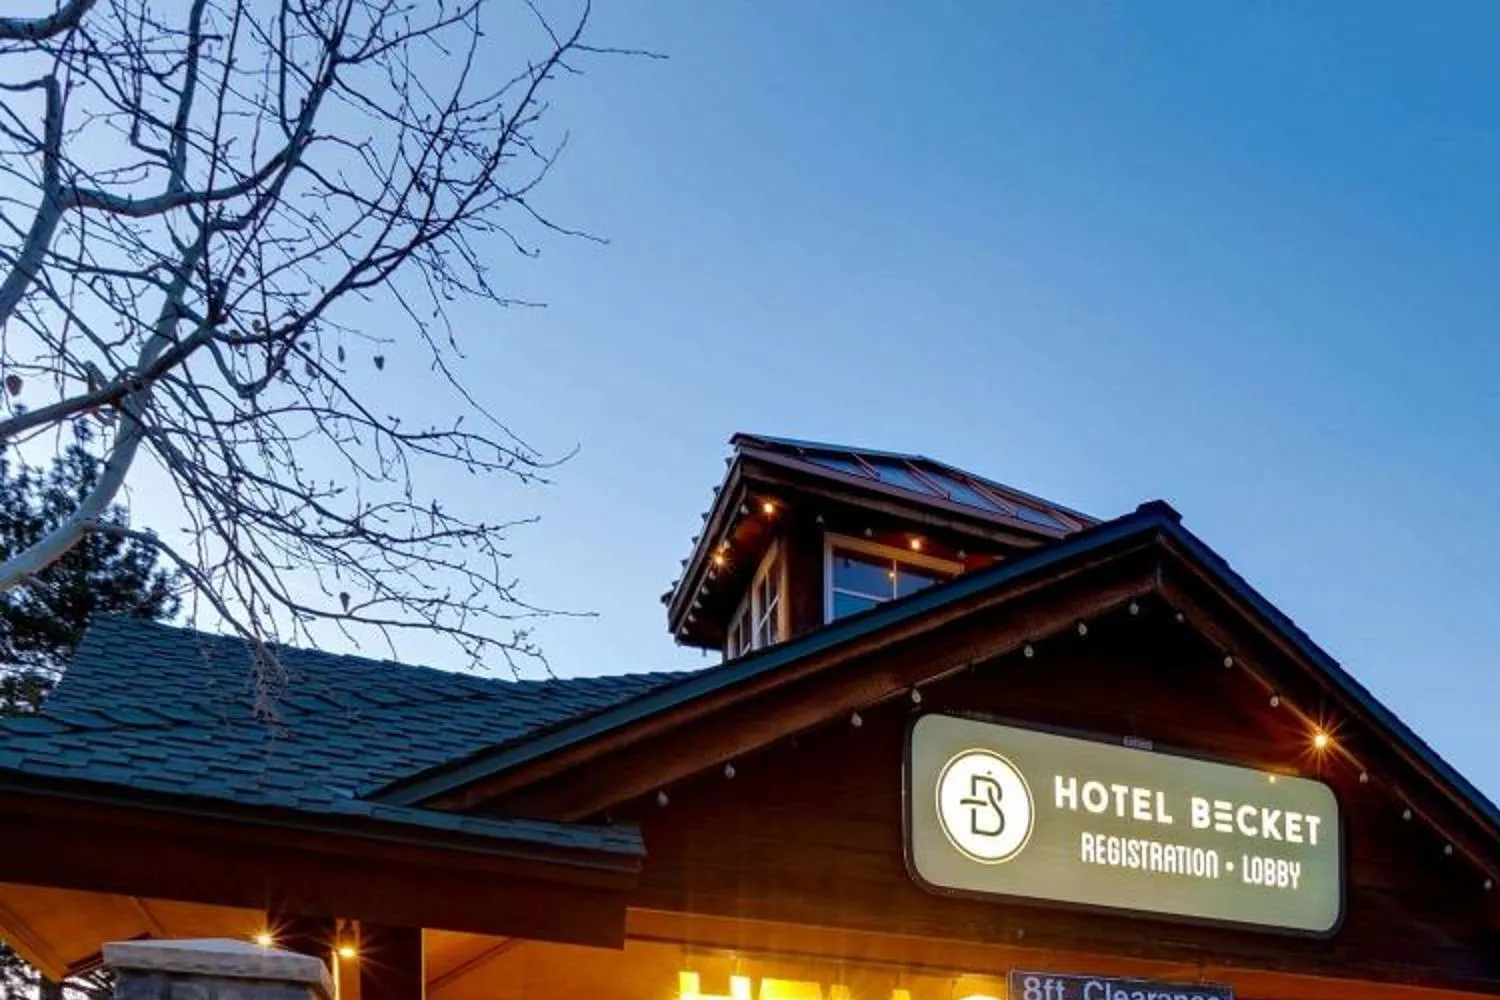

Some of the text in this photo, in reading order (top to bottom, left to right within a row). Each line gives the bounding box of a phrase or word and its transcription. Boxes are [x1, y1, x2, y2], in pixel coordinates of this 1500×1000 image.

[1054, 775, 1321, 846] HOTEL BECKET
[1081, 832, 1301, 890] REGISTRATION LOBBY
